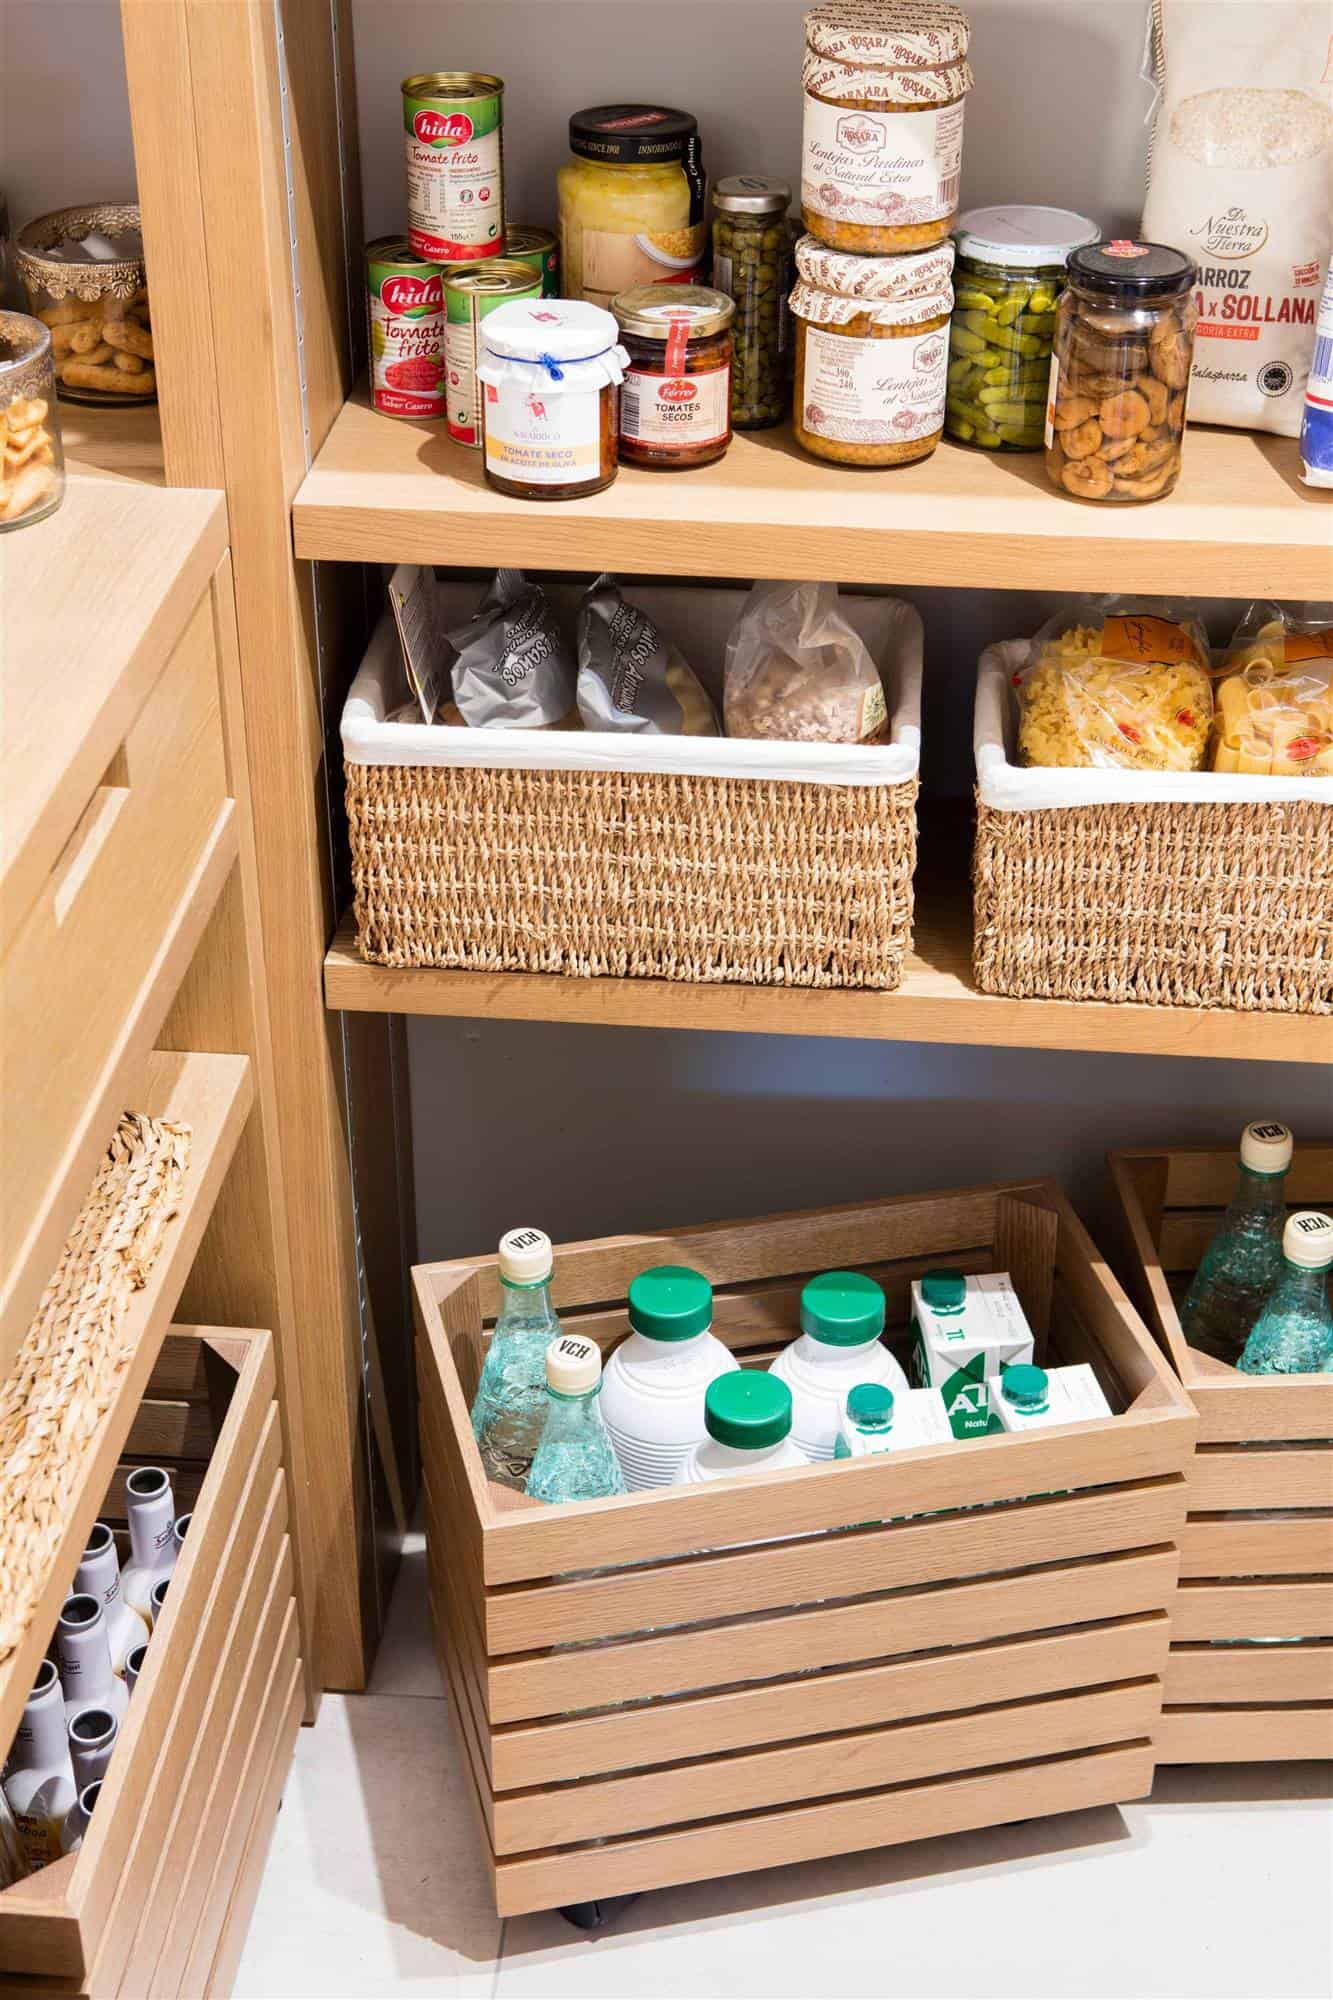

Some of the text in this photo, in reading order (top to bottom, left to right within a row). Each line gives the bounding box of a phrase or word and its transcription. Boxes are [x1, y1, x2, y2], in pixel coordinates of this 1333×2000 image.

[420, 118, 462, 137] hida
[411, 145, 479, 165] Tomate frito
[687, 137, 699, 176] Cebolla
[808, 141, 854, 166] Lentejas
[825, 166, 876, 183] Natural
[1190, 216, 1264, 237] Nuestra
[1207, 235, 1251, 251] Tierra
[390, 284, 441, 304] hida
[1220, 293, 1317, 325] SOLLANA
[398, 339, 440, 357] frito
[662, 387, 697, 398] Ferrer
[655, 402, 701, 412] TOMATES
[662, 413, 694, 421] SECOS
[503, 446, 573, 459] TOMATE SECO
[1253, 1124, 1285, 1139] VCH
[1296, 1216, 1331, 1233] VCH
[509, 1231, 542, 1250] VCH
[559, 1339, 592, 1360] VCH
[964, 1420, 989, 1429] Natu
